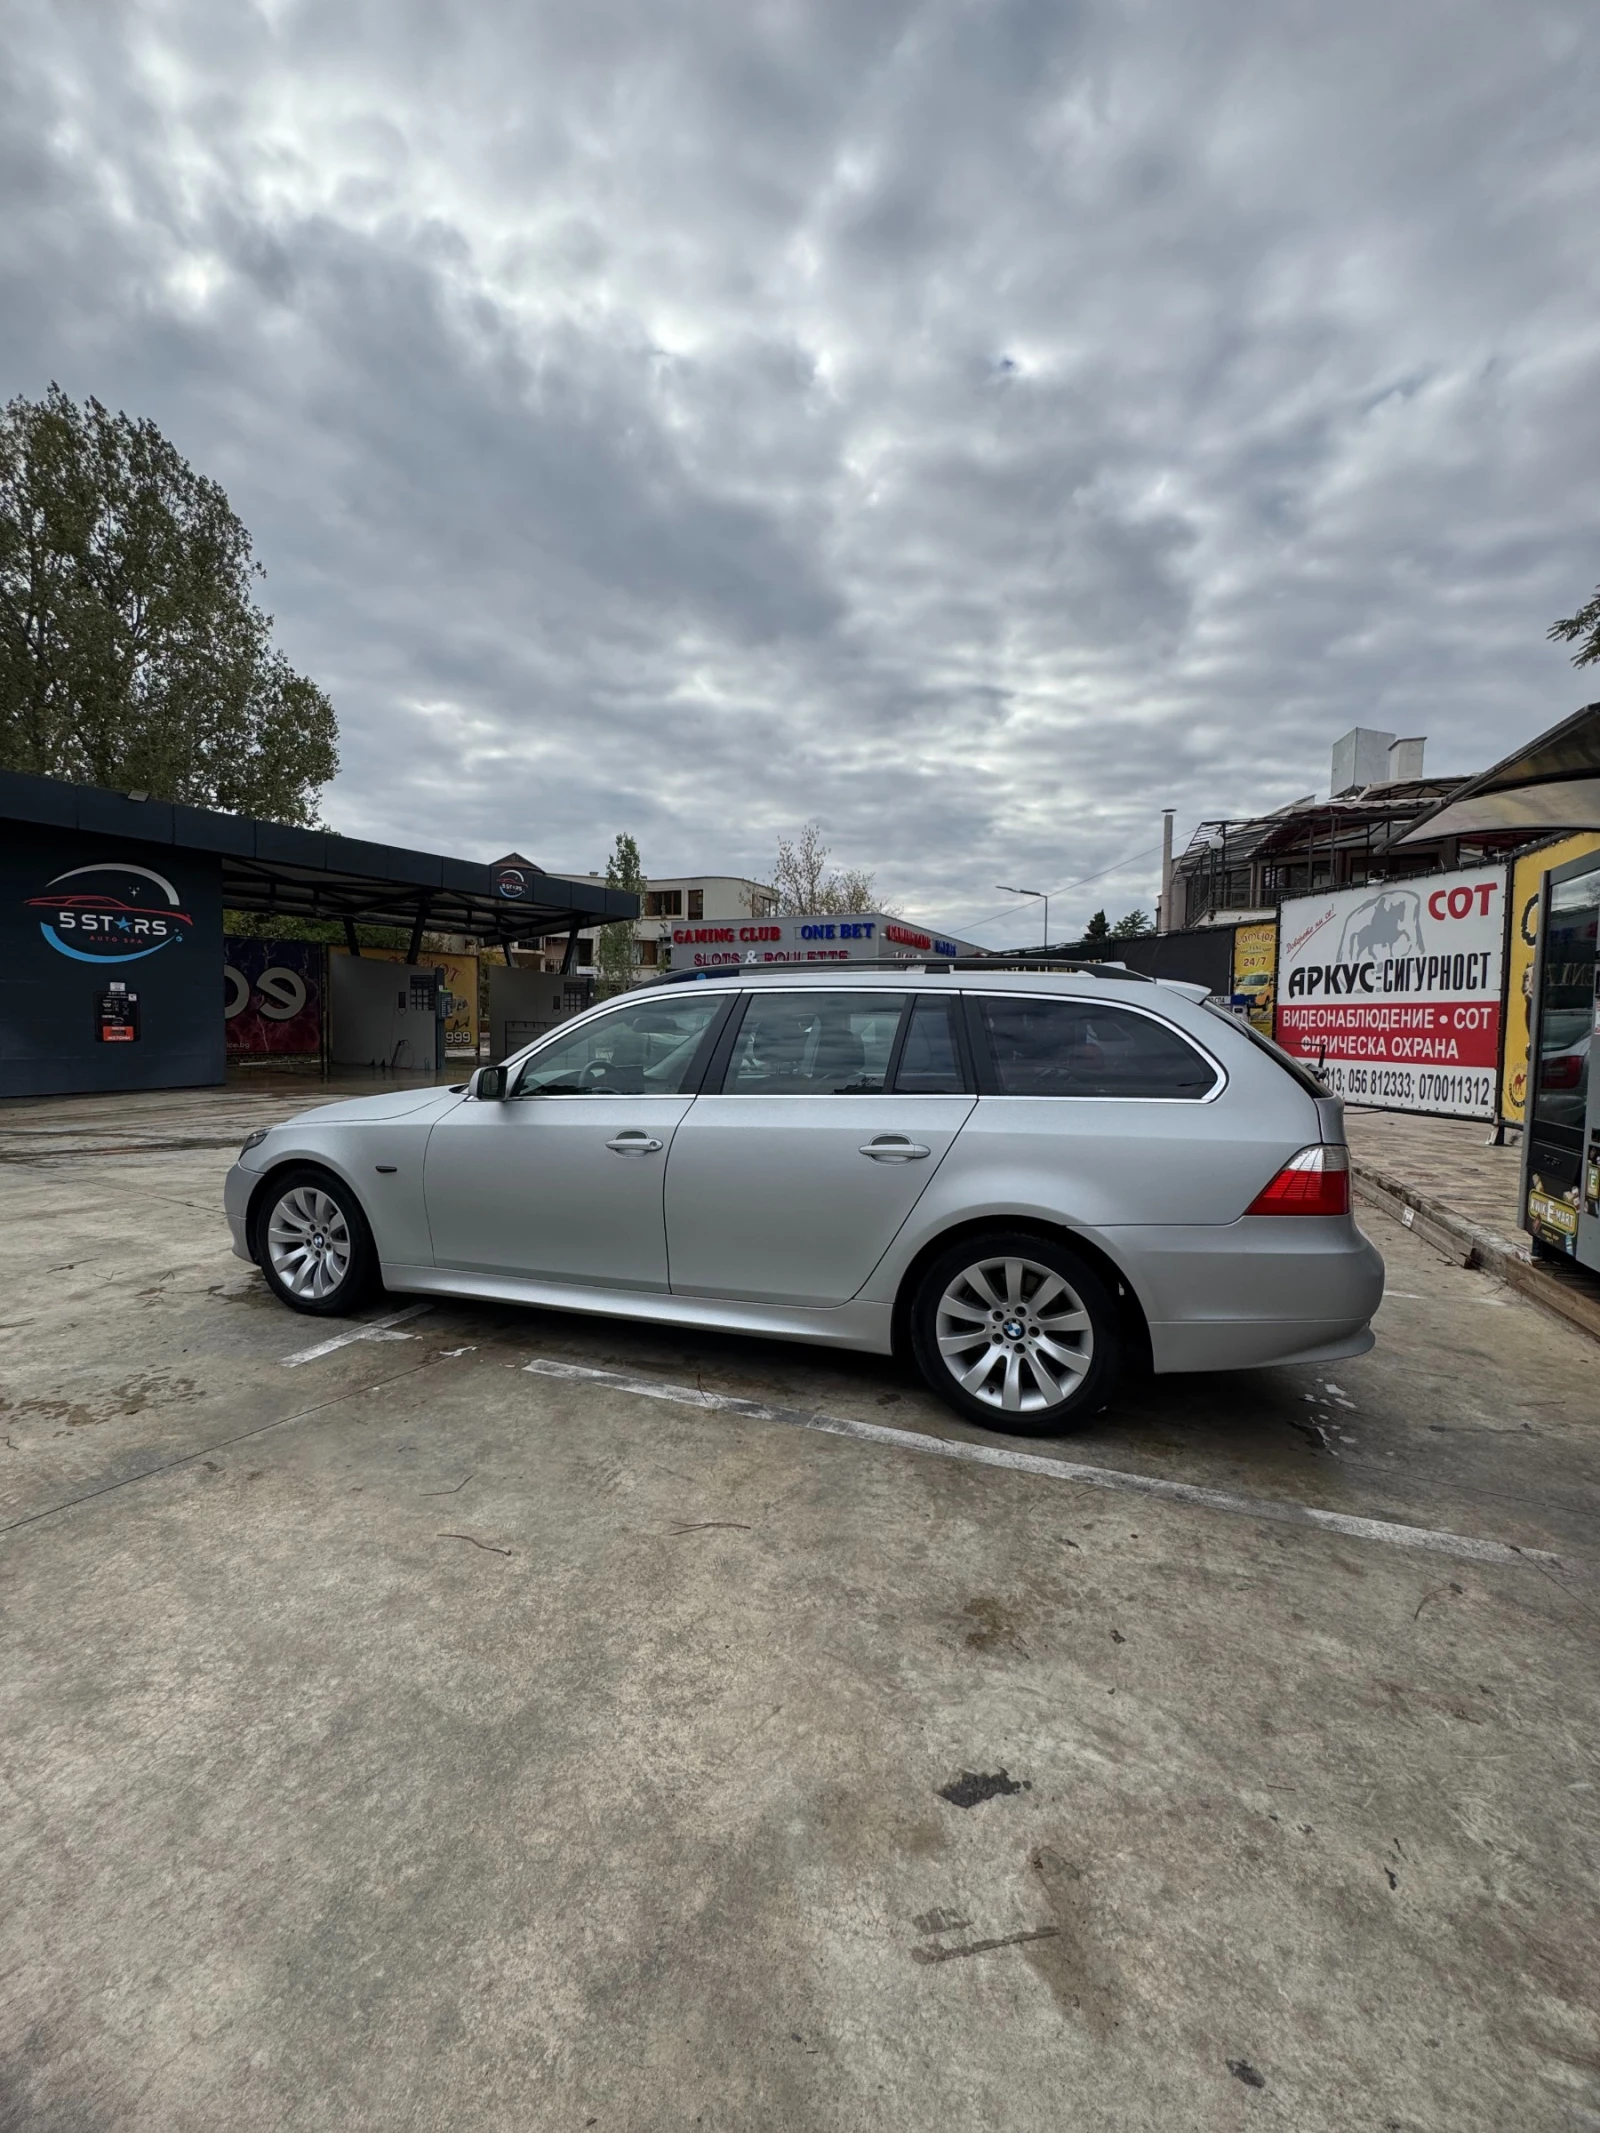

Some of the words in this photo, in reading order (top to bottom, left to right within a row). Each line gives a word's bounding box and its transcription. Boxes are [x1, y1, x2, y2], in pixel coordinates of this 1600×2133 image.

[1428, 882, 1498, 921] СОТ
[59, 911, 76, 929] 5
[89, 935, 118, 943] AUTO
[673, 927, 735, 944] GAMING
[739, 926, 781, 943] CLUB
[801, 923, 836, 940] ONE
[840, 922, 876, 939] BET
[693, 952, 741, 966] SLOTS
[745, 949, 758, 964] &
[1243, 956, 1267, 967] 24/7
[1282, 1008, 1435, 1032] ВИДЕОНАБЛЮДЕНИЕ
[1453, 1007, 1492, 1030] СОТ
[1300, 1035, 1387, 1056] ФИЗИЧЕСКА
[1391, 1036, 1459, 1059] ОХРАНА
[1348, 1068, 1367, 1094] 056
[1370, 1070, 1416, 1103] 812333;
[1419, 1073, 1490, 1106] 070011312
